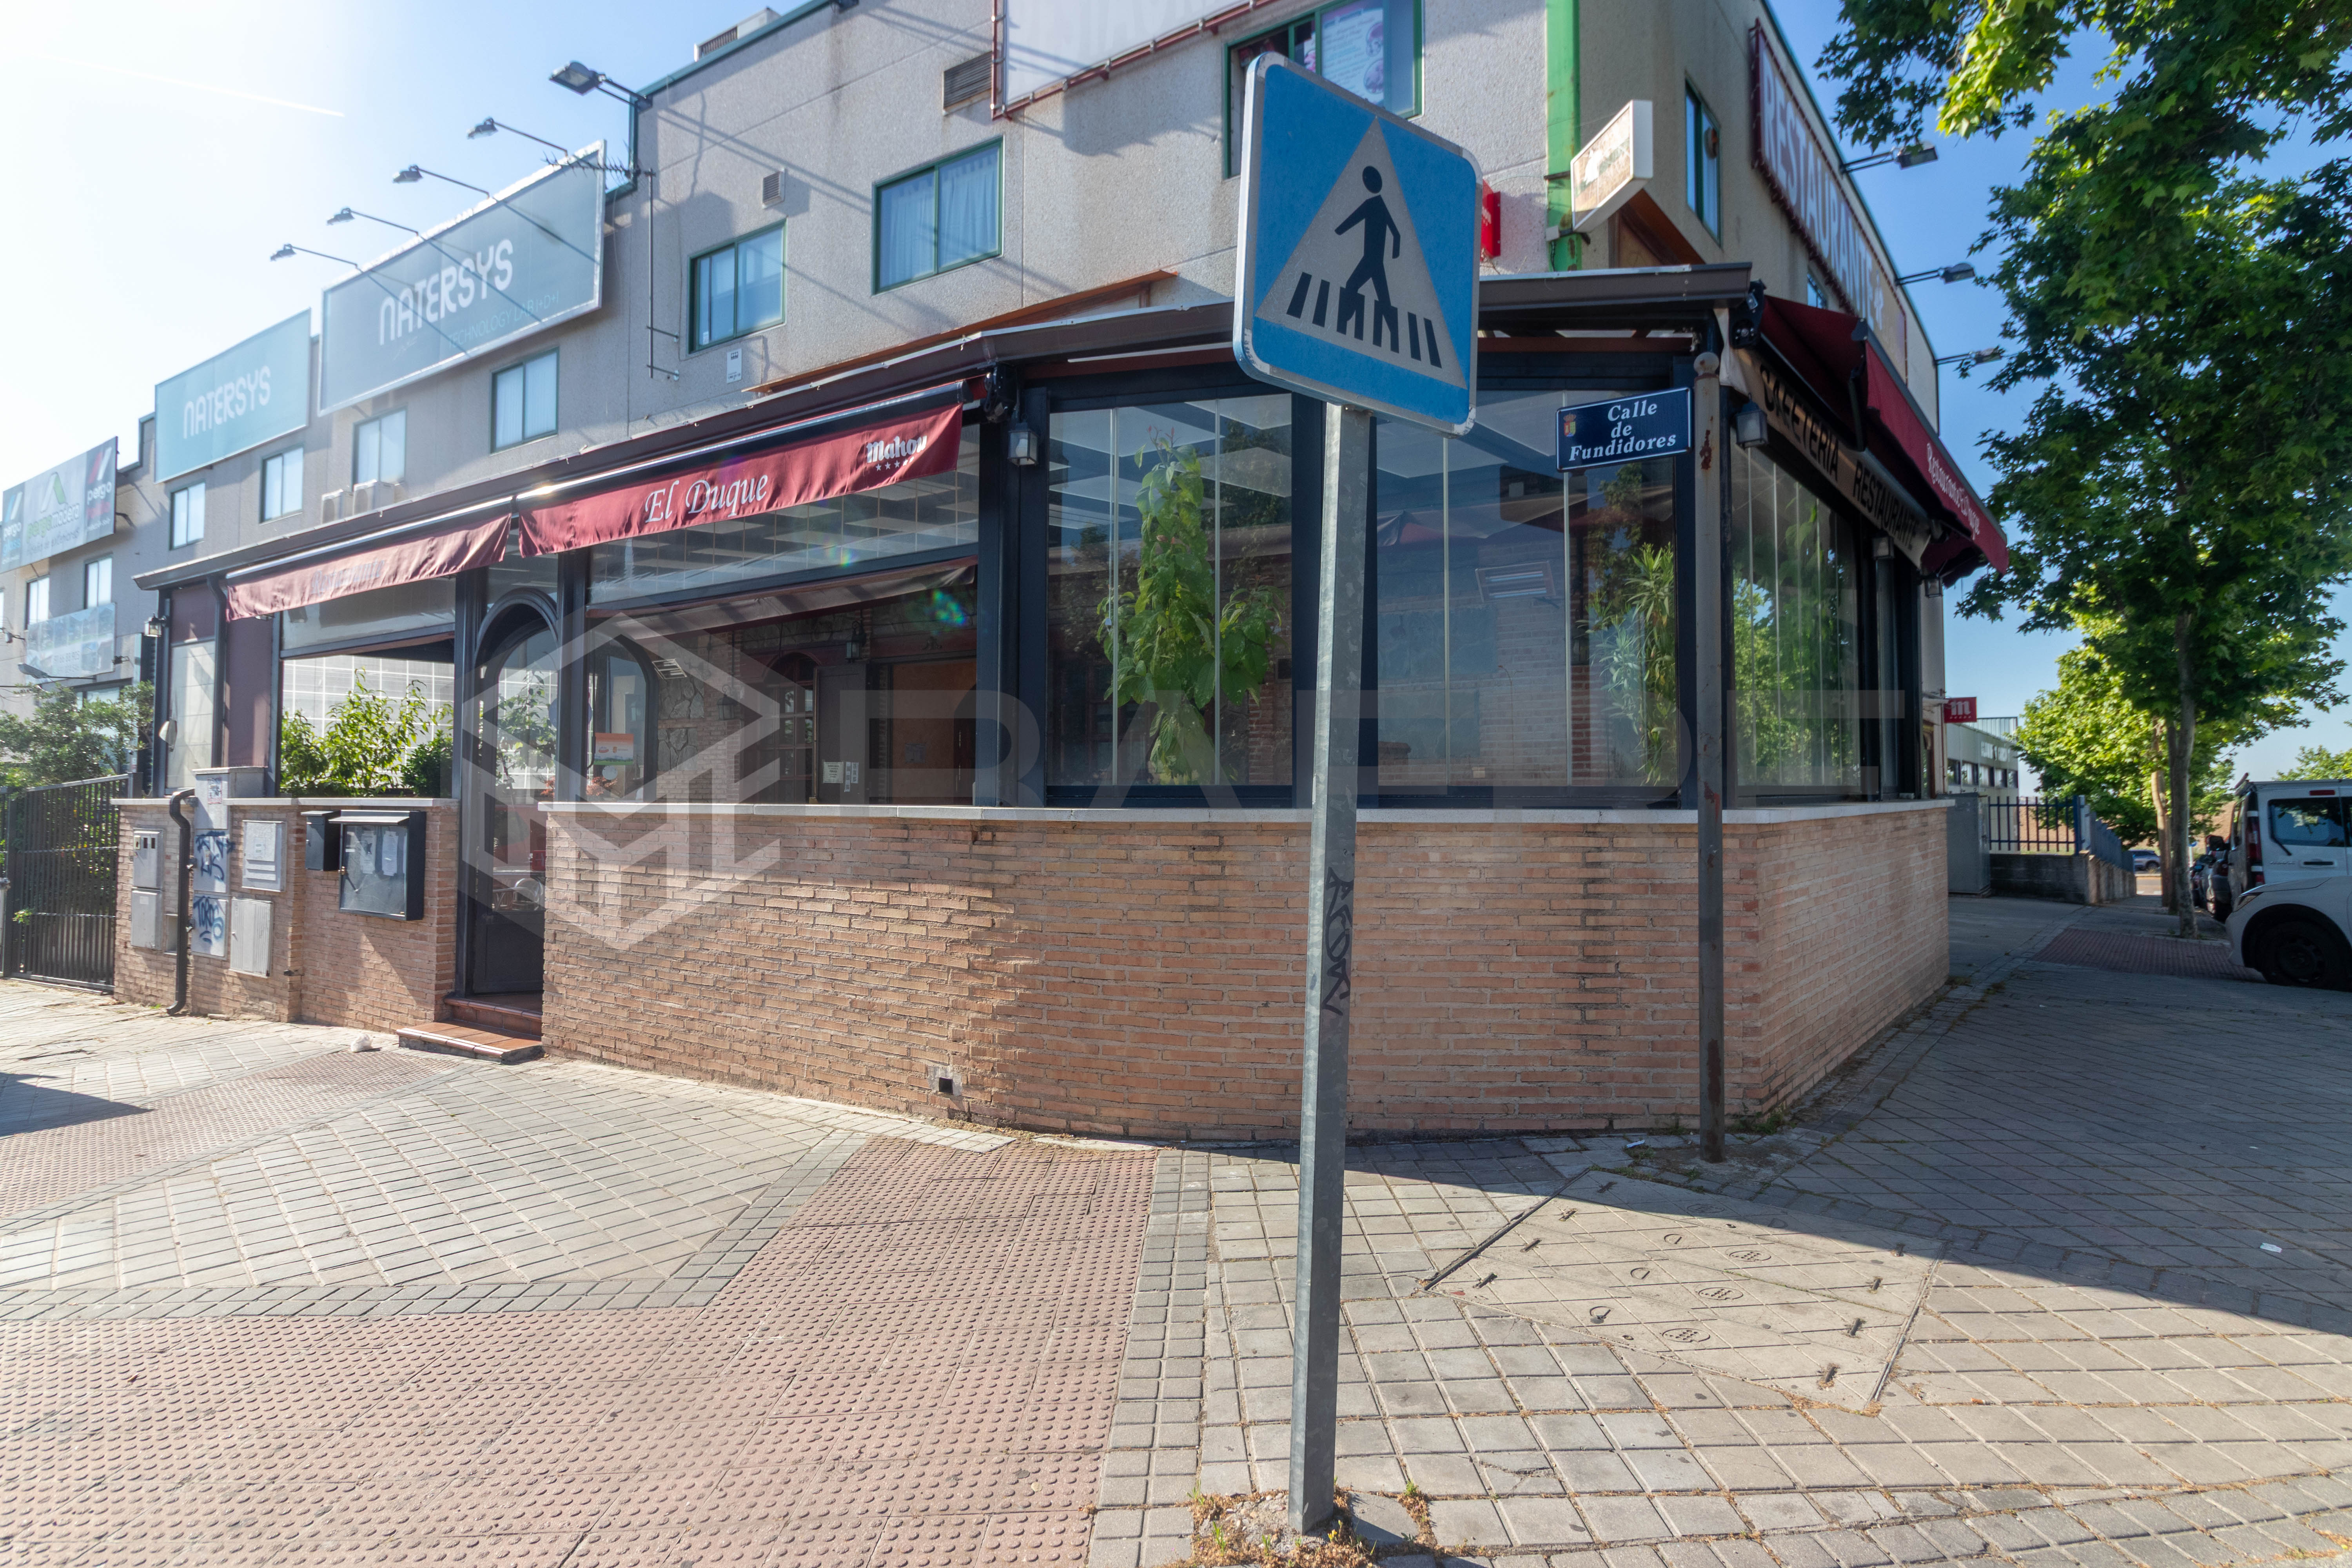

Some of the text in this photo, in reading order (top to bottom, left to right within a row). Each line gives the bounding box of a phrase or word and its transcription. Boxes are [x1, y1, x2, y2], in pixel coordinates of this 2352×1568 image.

[1760, 45, 1875, 332] RESTAURANTE
[379, 238, 514, 347] NATERSYS
[448, 310, 511, 348] TECHNOLOGY
[514, 299, 534, 322] LAB
[183, 365, 271, 439] NATERSYS
[1607, 399, 1658, 422] Calle
[1760, 363, 1838, 482] CAFETERIA
[866, 436, 927, 463] Mahou
[1568, 434, 1677, 462] Fundidores
[1611, 421, 1632, 438] de
[644, 474, 768, 523] El Duque
[311, 559, 387, 597] Restaurante
